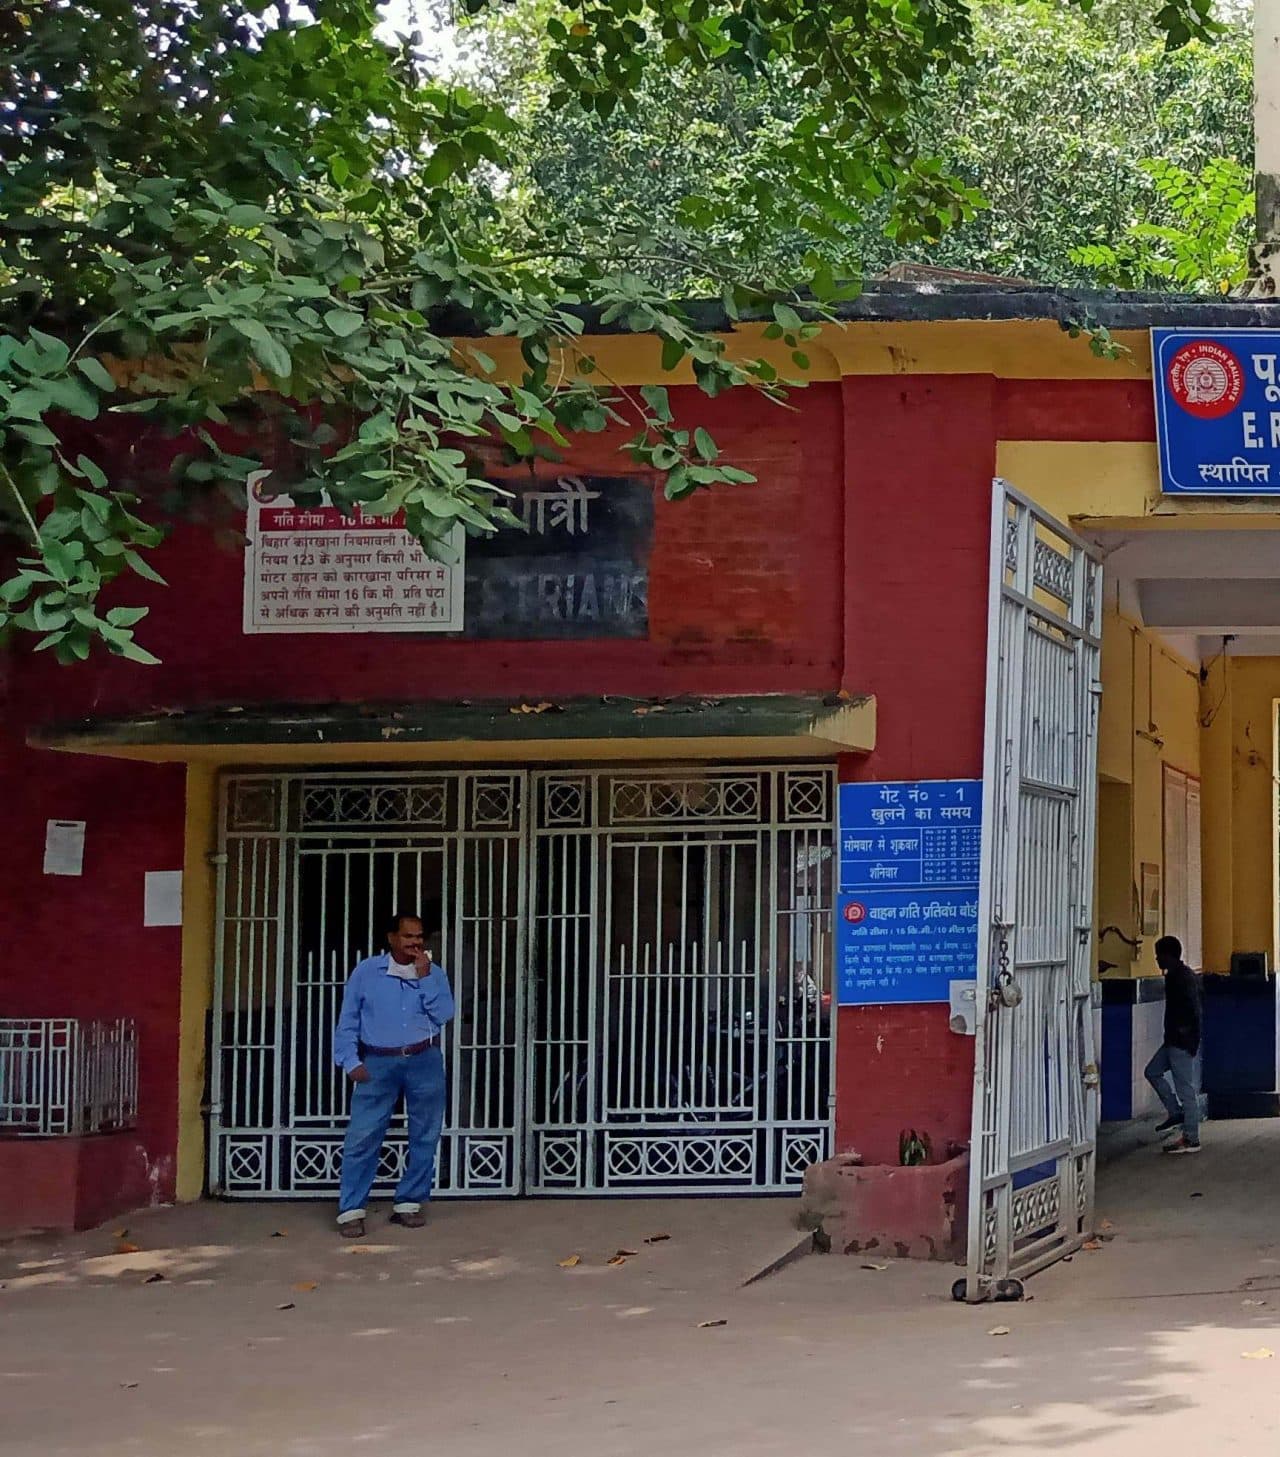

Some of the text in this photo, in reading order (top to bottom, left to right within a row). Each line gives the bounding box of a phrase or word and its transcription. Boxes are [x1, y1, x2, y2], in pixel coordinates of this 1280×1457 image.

[1199, 345, 1241, 402] INDIAN RAILWAYS
[1242, 411, 1264, 449] E.
[1198, 456, 1271, 484] स्थापित
[273, 510, 294, 527] गति
[261, 533, 289, 550] बिहार
[344, 532, 396, 547] नियमावली
[261, 552, 288, 566] नियम
[293, 552, 314, 566] 123
[319, 551, 330, 565] के
[335, 552, 371, 568] अनुसार
[376, 550, 405, 565] किसी
[409, 550, 422, 564] भी
[323, 569, 338, 582] को
[343, 570, 391, 583] कारखाना
[397, 567, 431, 581] परिसर
[261, 587, 289, 601] अपनी
[317, 586, 340, 600] सीमा
[344, 588, 359, 601] 16
[403, 586, 422, 600] प्रति
[275, 604, 309, 619] अधिक
[314, 604, 339, 618] करने
[344, 604, 360, 617] की
[365, 604, 402, 620] अनुमति
[879, 785, 900, 804] गेट
[955, 787, 964, 802] 1
[871, 803, 972, 825] खुलने का समय
[843, 835, 873, 852] सोमवार
[878, 835, 886, 851] से
[890, 838, 919, 856] शुक्रवार
[869, 862, 899, 879] शनिवार
[869, 906, 897, 921] वाहन
[899, 901, 920, 919] गति
